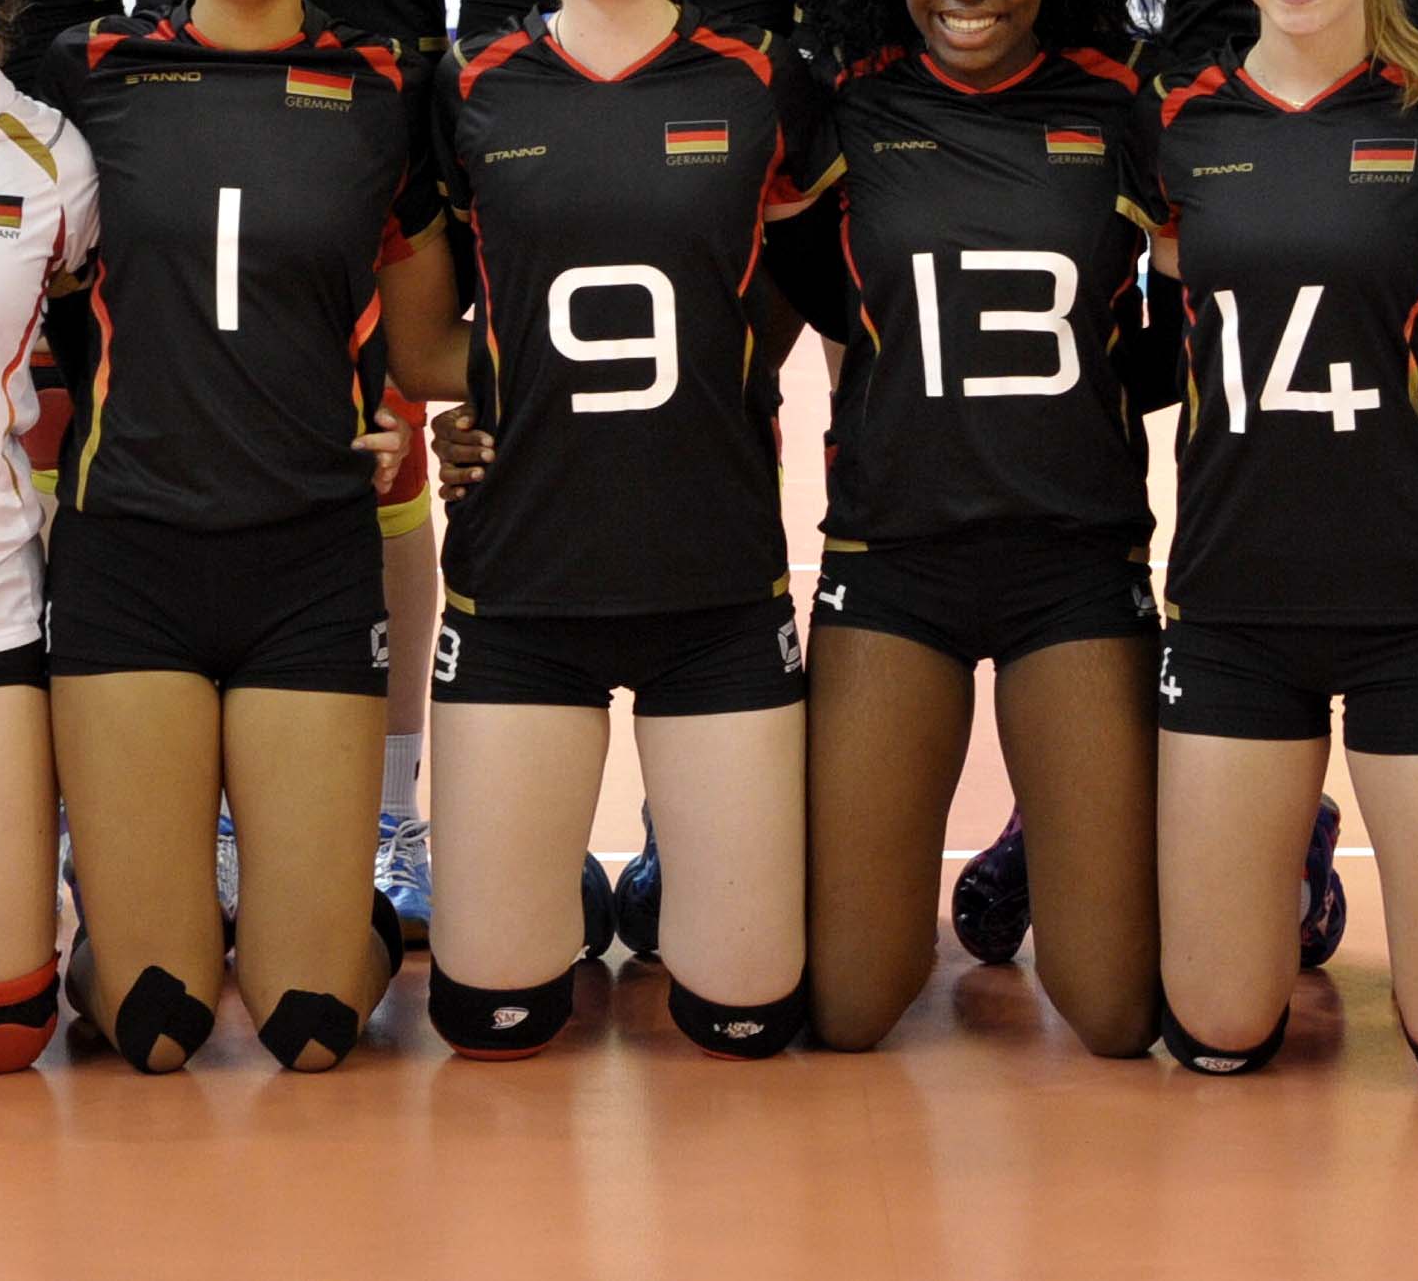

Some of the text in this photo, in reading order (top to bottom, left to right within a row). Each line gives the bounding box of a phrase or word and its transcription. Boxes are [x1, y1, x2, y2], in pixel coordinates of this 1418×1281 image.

[125, 72, 202, 85] STANNO
[284, 96, 352, 113] GERMANY
[484, 145, 547, 164] STANNO
[872, 140, 938, 153] STANNO
[666, 153, 729, 166] GERMANY
[1193, 162, 1254, 178] STANNO
[1349, 173, 1413, 185] GERMANY
[217, 188, 243, 332] 1
[913, 251, 1082, 398] 13
[548, 265, 680, 414] 9
[1214, 286, 1382, 435] 14
